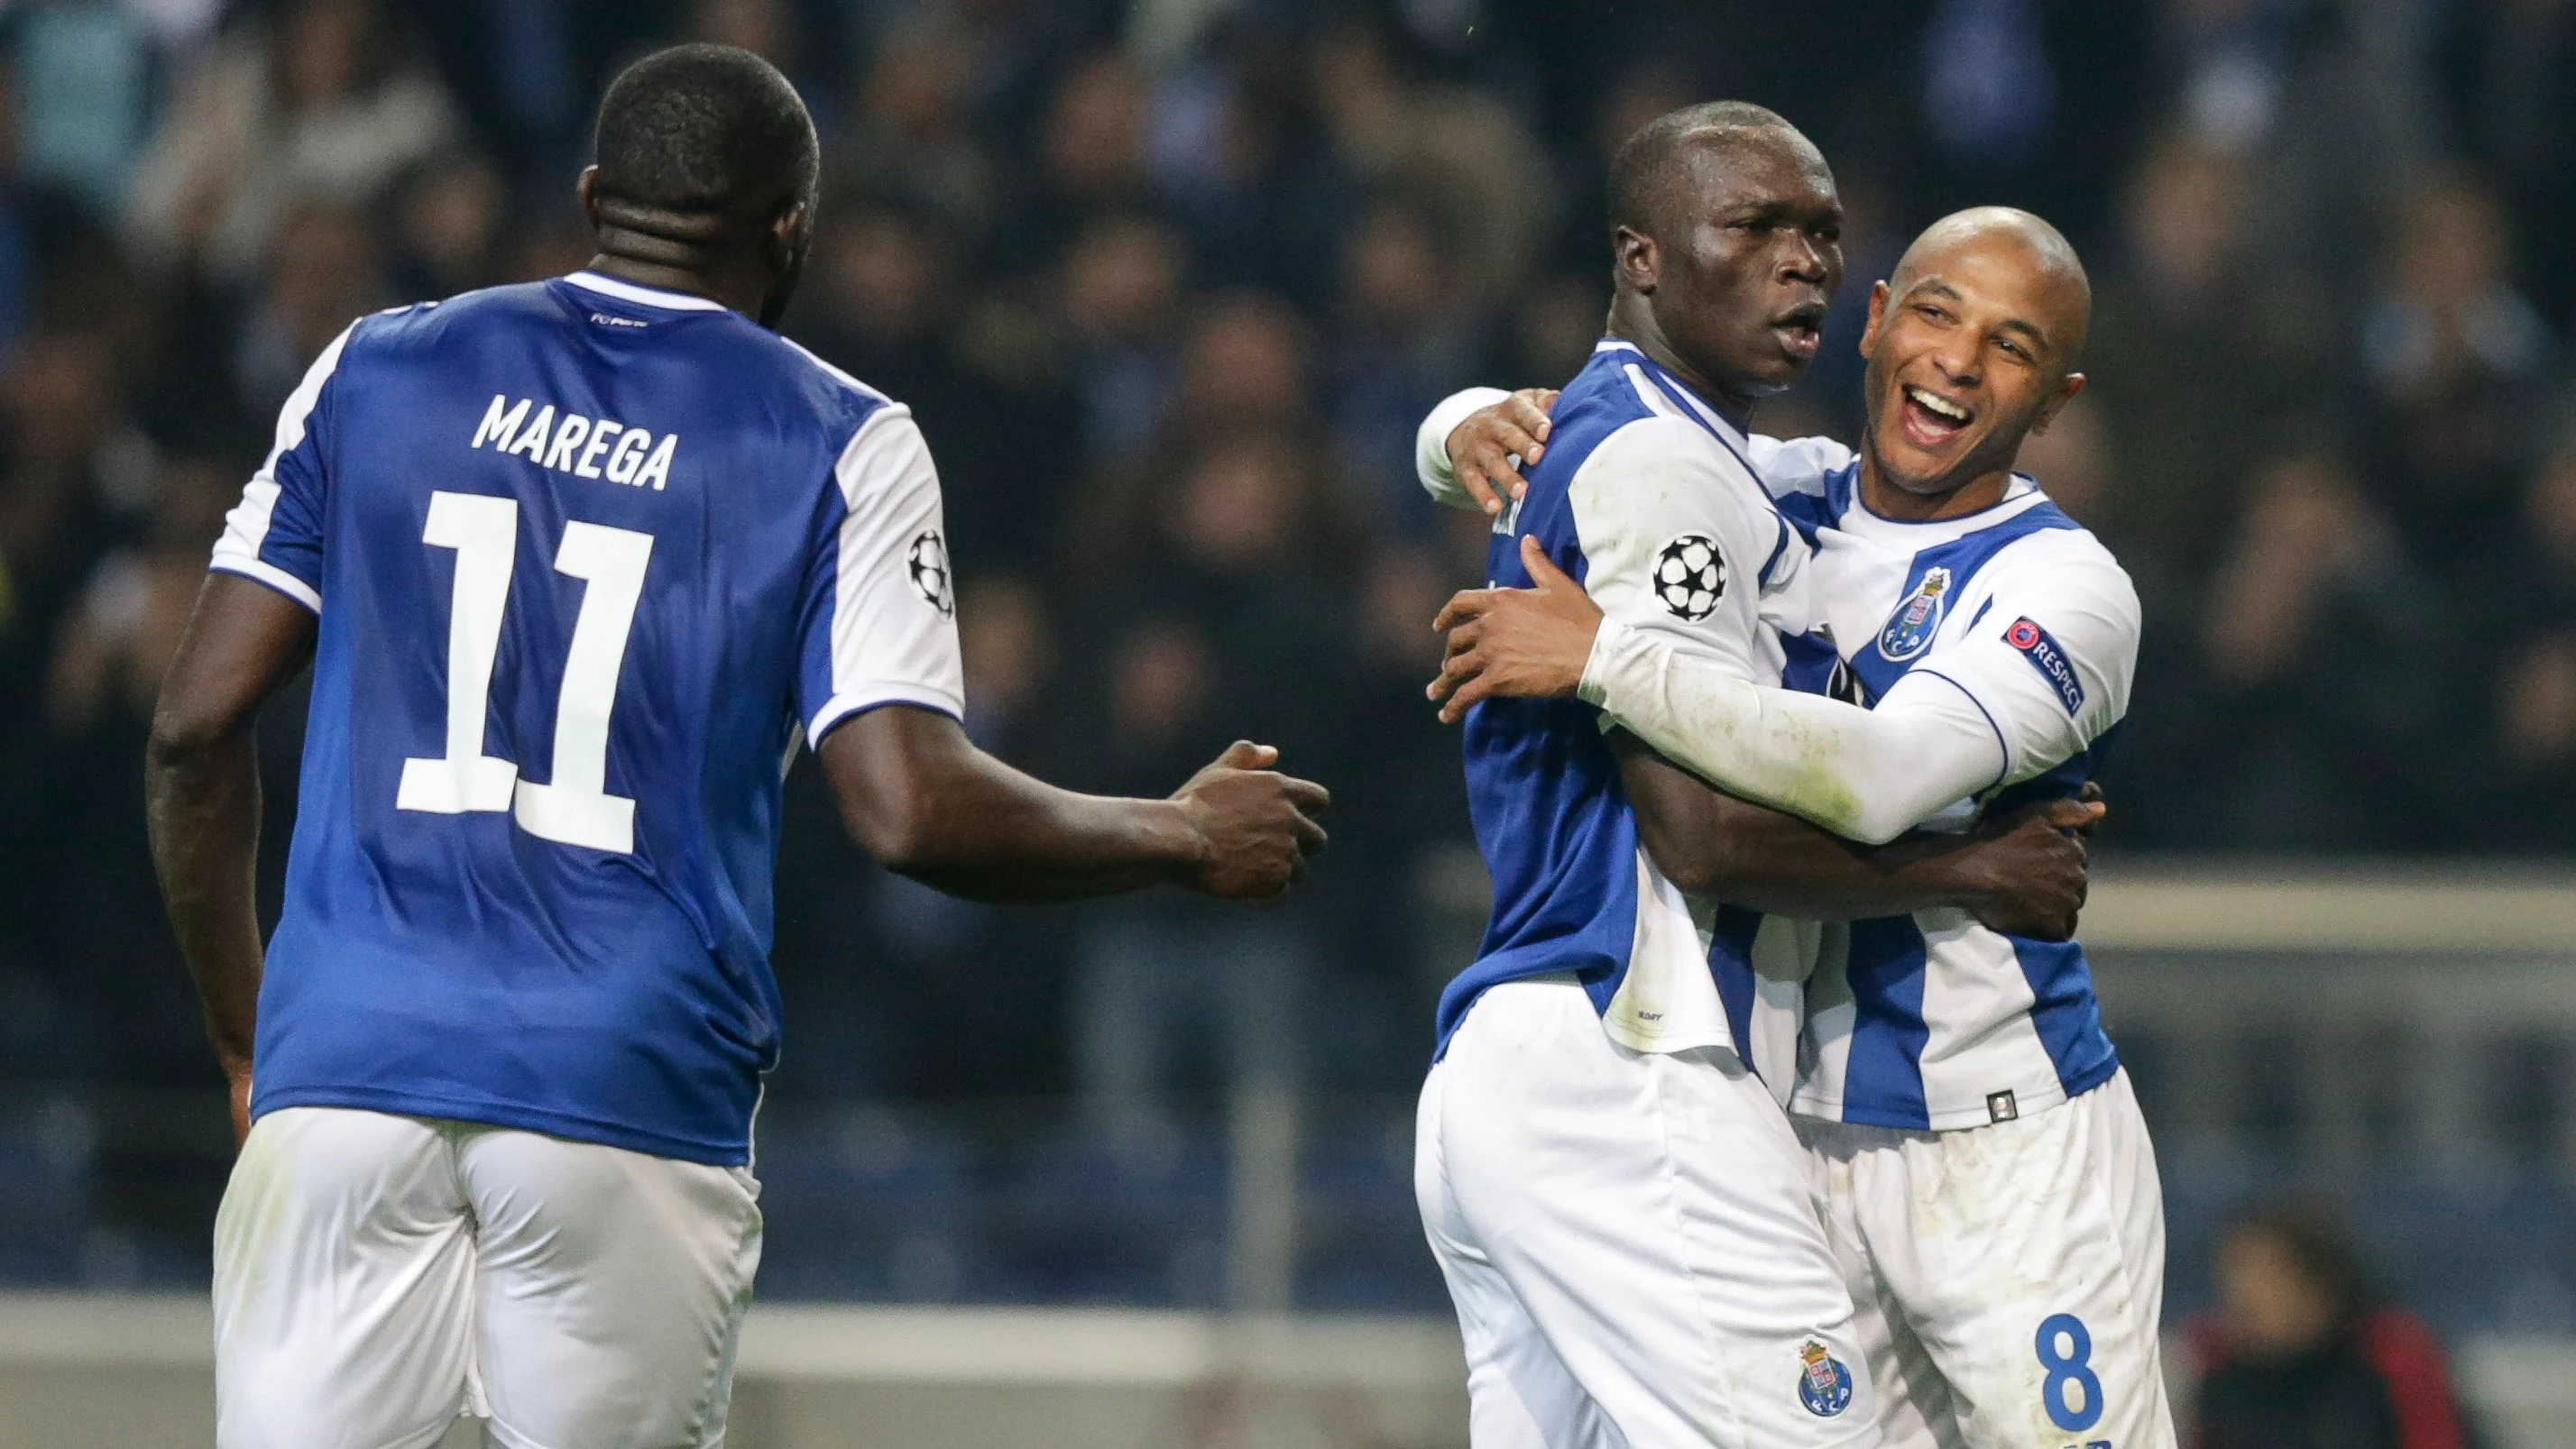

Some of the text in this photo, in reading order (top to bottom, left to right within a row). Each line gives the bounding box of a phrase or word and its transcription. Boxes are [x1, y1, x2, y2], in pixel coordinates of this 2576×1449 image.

[471, 393, 678, 491] MAREGA
[396, 490, 655, 855] 11
[2032, 641, 2081, 711] RESPECT
[2035, 1313, 2104, 1432] 8
